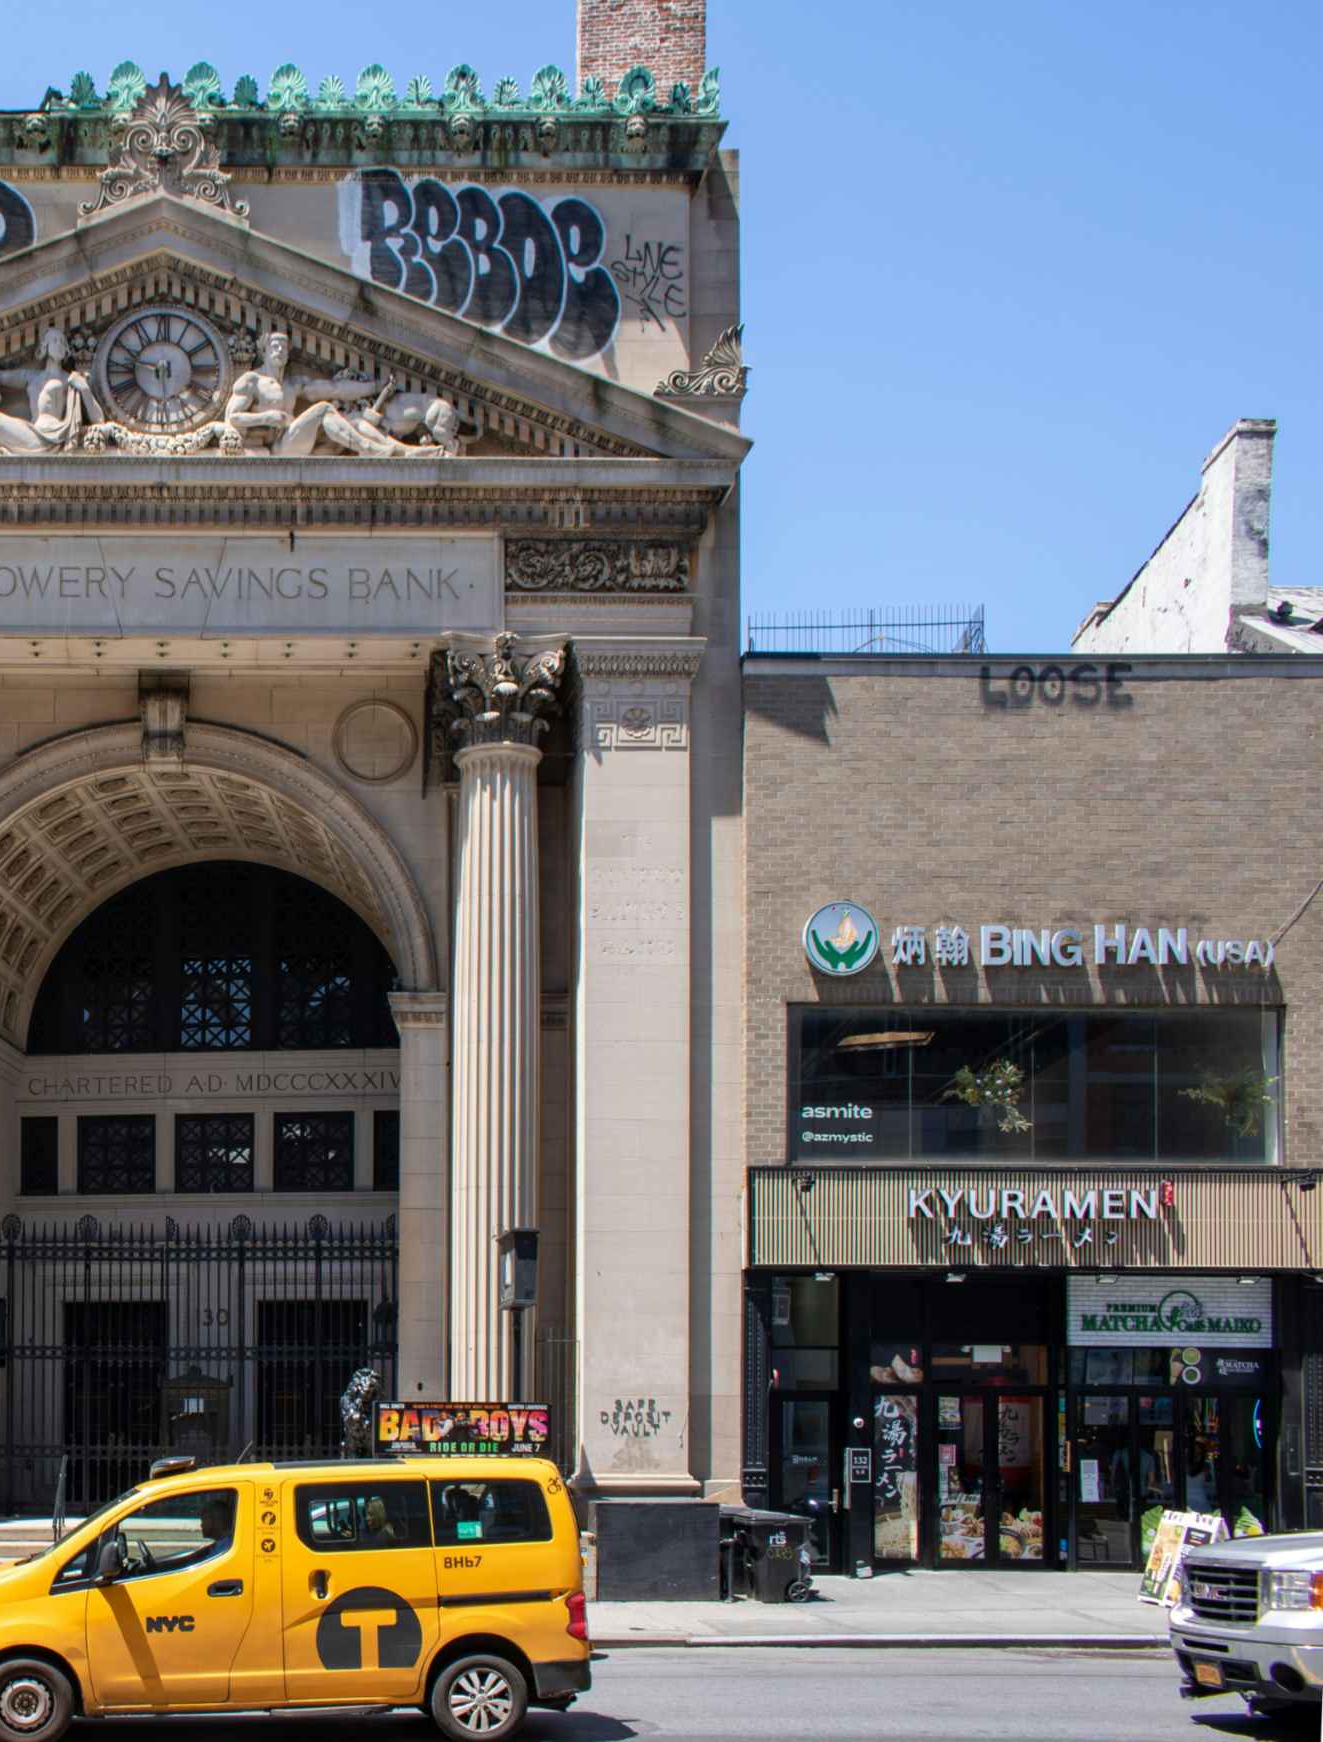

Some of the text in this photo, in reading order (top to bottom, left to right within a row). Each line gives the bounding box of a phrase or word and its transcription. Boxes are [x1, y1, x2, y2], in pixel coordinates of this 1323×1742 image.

[154, 566, 329, 599] SAVINGS
[348, 567, 460, 600] BANK
[979, 662, 1134, 710] LOOSE
[981, 925, 1083, 967] BING
[1094, 924, 1188, 967] HAN
[1195, 938, 1276, 967] (USA)
[27, 1075, 173, 1097] CHARTERED
[801, 1103, 873, 1119] asmite
[801, 1130, 873, 1144] @azmystic
[908, 1188, 1158, 1220] KYURAMEN
[1107, 1304, 1158, 1313] PREMIUM
[1081, 1314, 1163, 1331] MATCHA
[1208, 1317, 1262, 1333] MAIKO
[614, 1399, 656, 1412] SAFE
[379, 1409, 549, 1441] BAD BOYS
[600, 1411, 671, 1424] DEPOSIT
[610, 1424, 660, 1437] VAULT
[430, 1443, 457, 1452] RIDE
[461, 1443, 476, 1452] OR
[480, 1443, 499, 1452] DIE
[511, 1443, 541, 1452] JUNE 7
[146, 1616, 195, 1632] NYC
